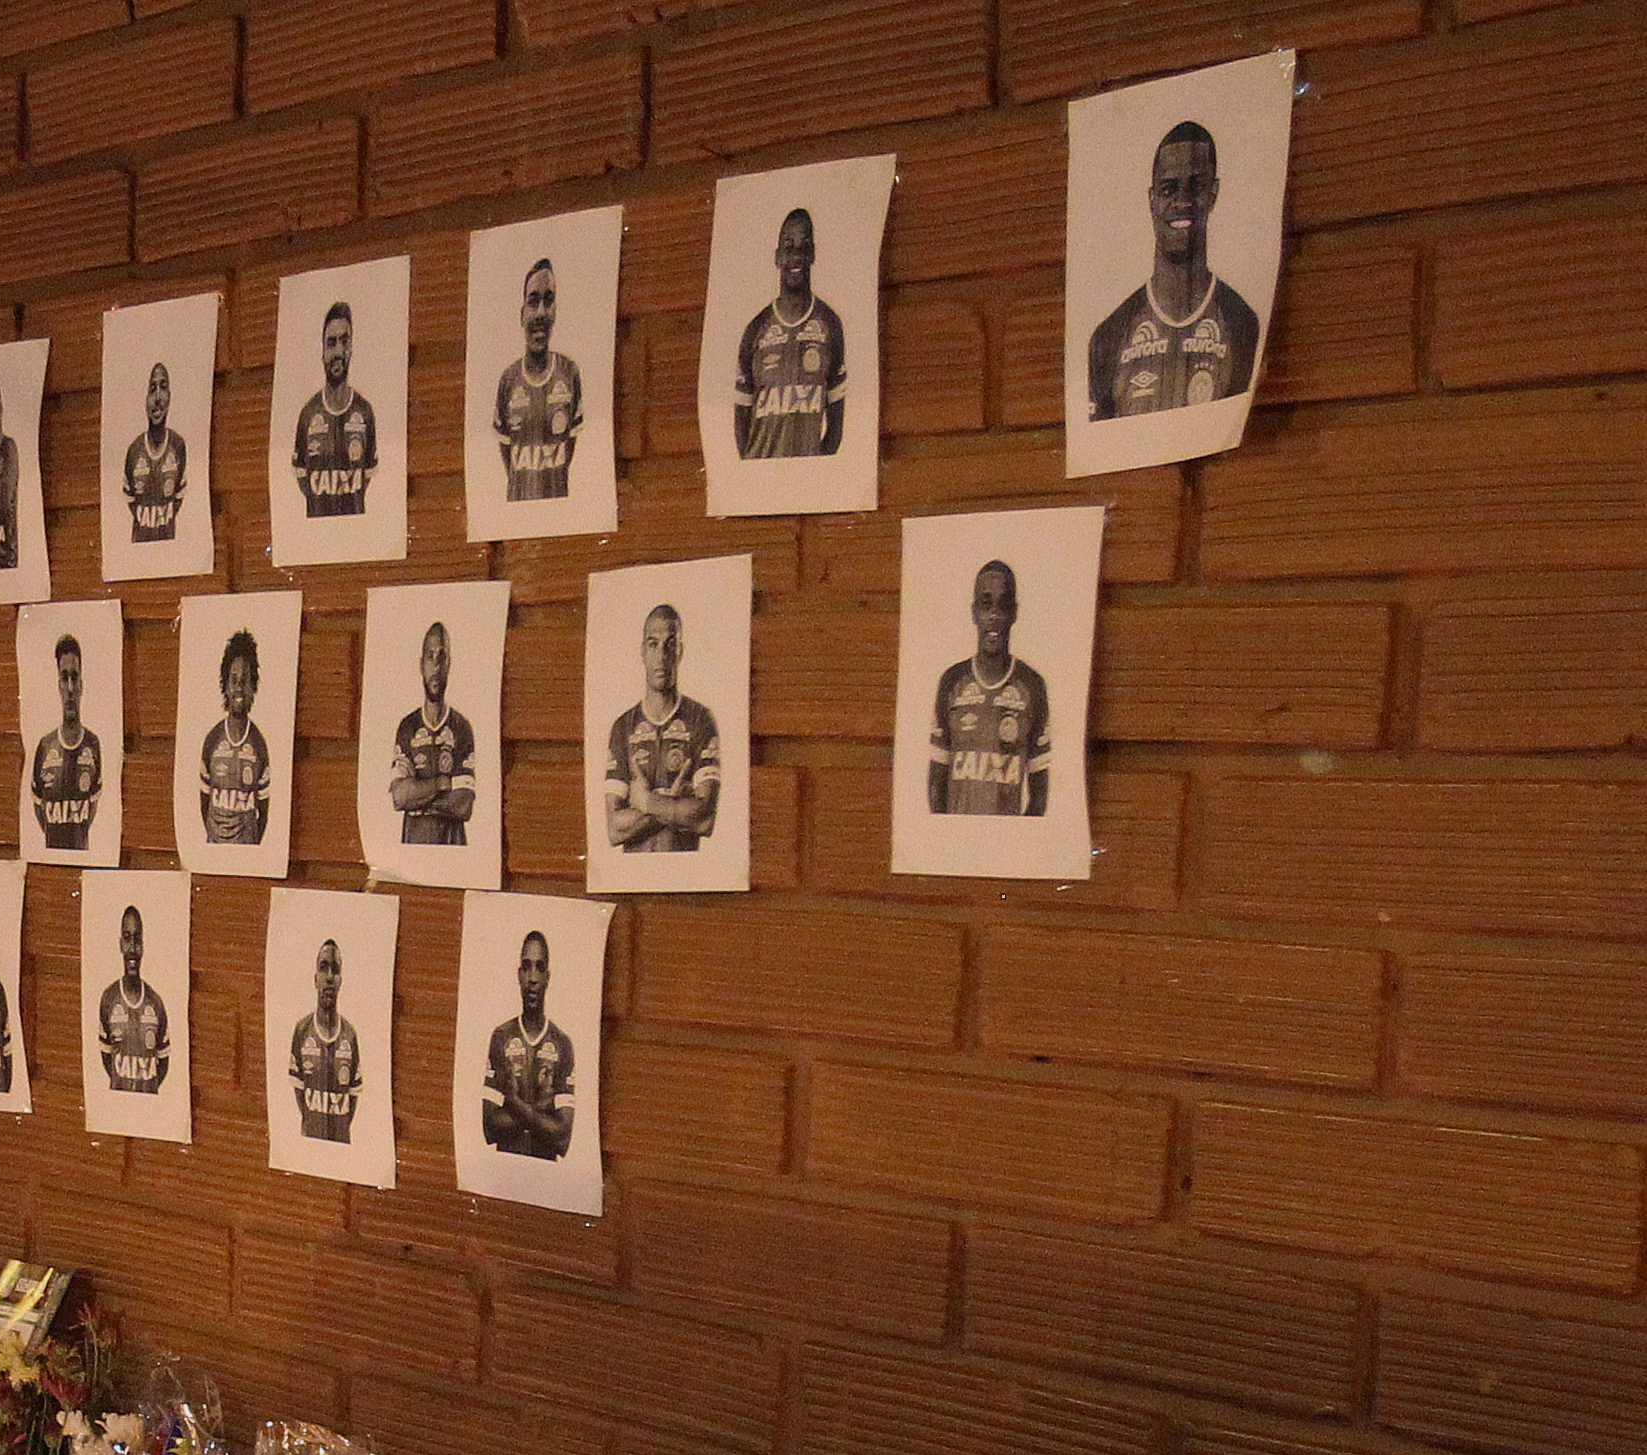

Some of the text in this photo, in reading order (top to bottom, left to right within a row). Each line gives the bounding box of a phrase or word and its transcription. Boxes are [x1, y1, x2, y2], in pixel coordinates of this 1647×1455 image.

[309, 468, 362, 496] CAIXA
[136, 501, 173, 528] CAIXA
[952, 750, 1020, 784] CAIXA
[45, 799, 90, 824] CAIXA
[211, 788, 255, 811] CAIXA
[114, 1053, 157, 1081] CAIXA
[304, 1087, 350, 1116] CAIXA
